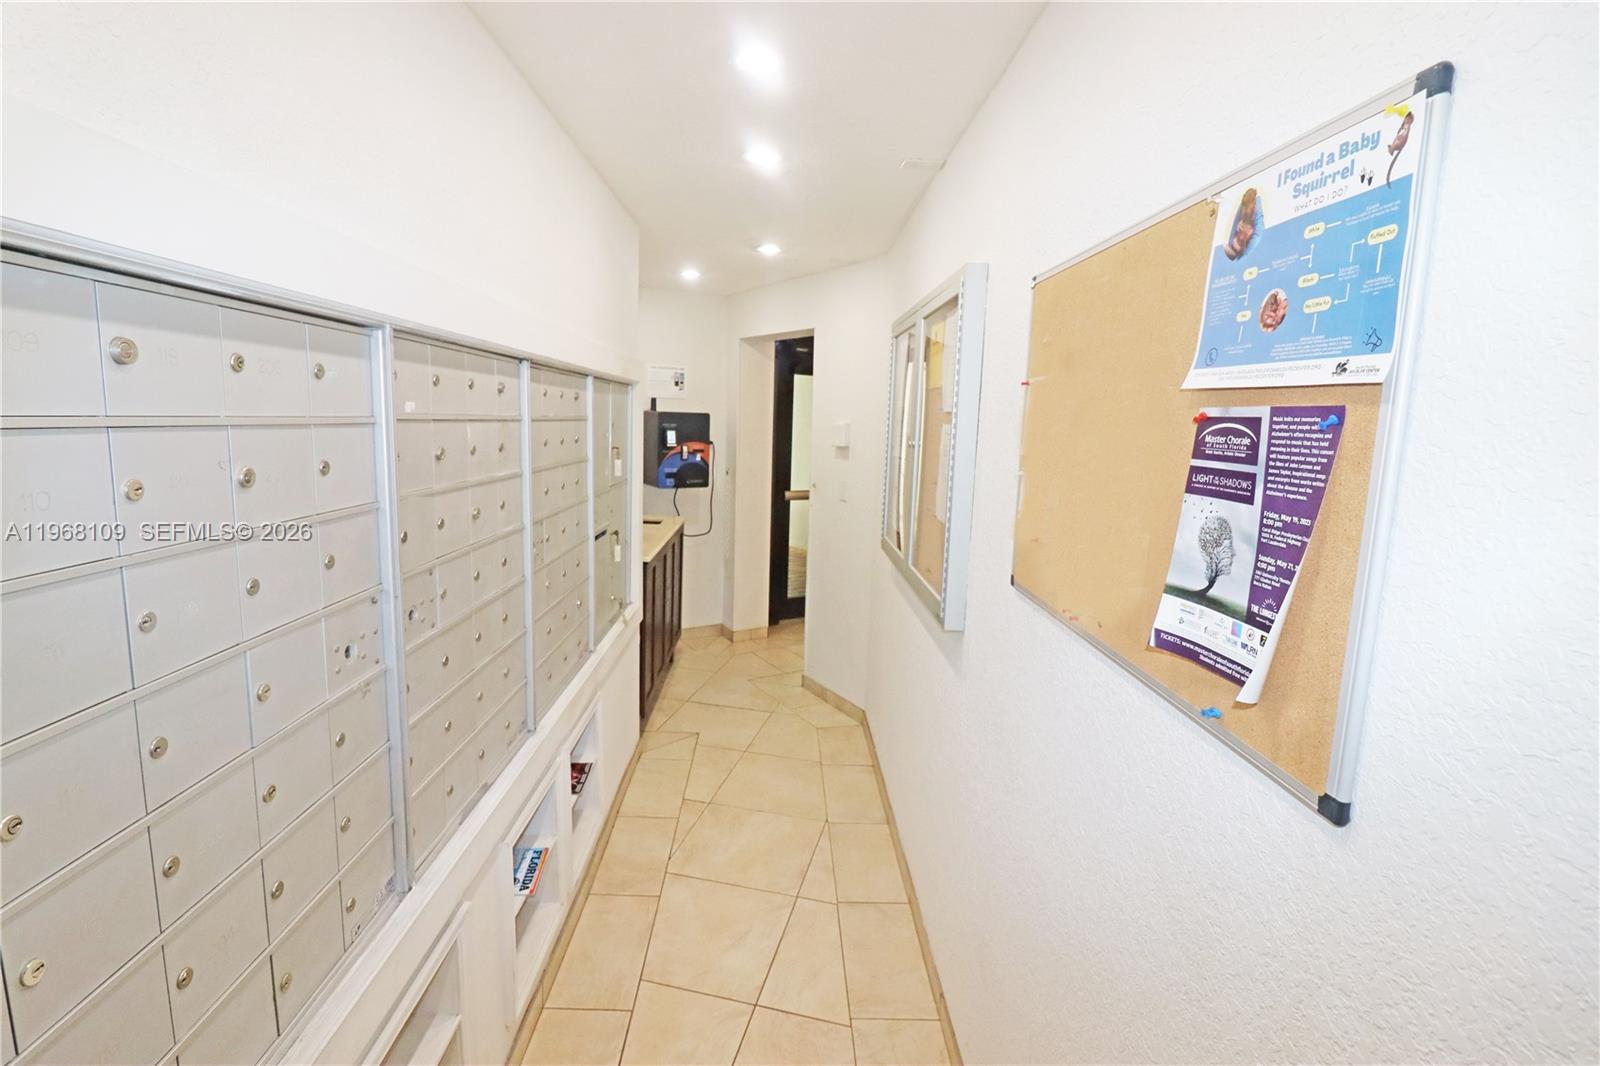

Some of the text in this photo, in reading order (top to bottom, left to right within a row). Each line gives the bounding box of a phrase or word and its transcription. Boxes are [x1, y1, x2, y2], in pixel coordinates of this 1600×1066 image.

[1277, 130, 1381, 188] I Found a Baby
[1292, 159, 1355, 199] Squirrel
[1294, 200, 1312, 212] WHAT
[1314, 195, 1325, 206] DO
[1205, 435, 1251, 445] Master Chorale
[1192, 473, 1214, 483] LIGHT
[1220, 477, 1252, 490] SHADOWS
[1263, 510, 1279, 521] Friday,
[1281, 514, 1291, 523] May
[1258, 554, 1276, 565] Sunday,
[1277, 559, 1287, 569] May
[1251, 603, 1259, 614] THE
[1160, 633, 1181, 645] TICKETS:
[519, 850, 542, 893] FLORIDA
